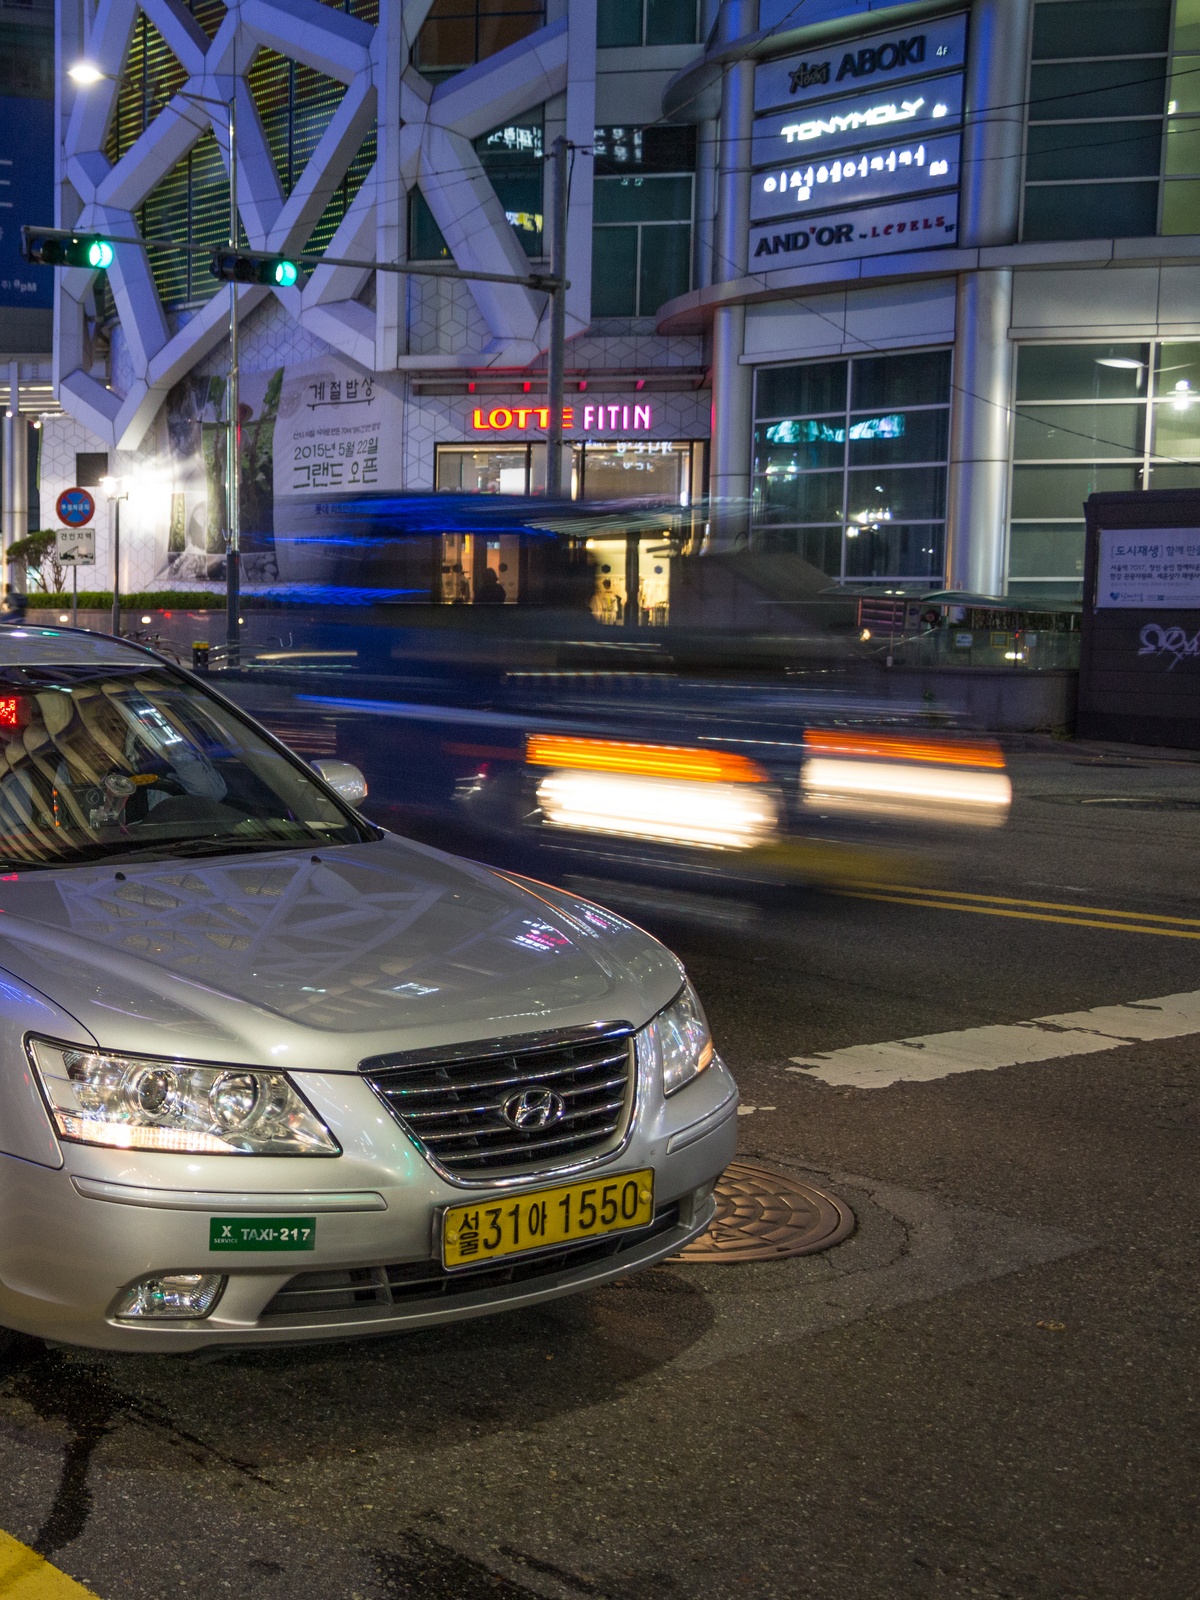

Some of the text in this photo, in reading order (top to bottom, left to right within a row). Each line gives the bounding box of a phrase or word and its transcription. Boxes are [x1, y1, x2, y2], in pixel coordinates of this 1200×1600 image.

[835, 35, 926, 82] ABOKI
[936, 45, 949, 58] 4F
[781, 97, 925, 142] TONYMOLY
[753, 223, 854, 258] AND'OR
[308, 377, 375, 401] 계절밥상
[473, 405, 651, 430] LOTTE FITIN
[294, 437, 379, 460] 2015년 5월 22일
[293, 457, 378, 489] 그랜드 오픈
[61, 503, 90, 512] 주정차금지
[60, 532, 92, 542] 견인지역
[1110, 545, 1163, 560] [도시재생]
[1166, 546, 1184, 557] 함께
[558, 1180, 639, 1235] 1550
[221, 1225, 232, 1237] X
[240, 1228, 311, 1241] TAXI-217
